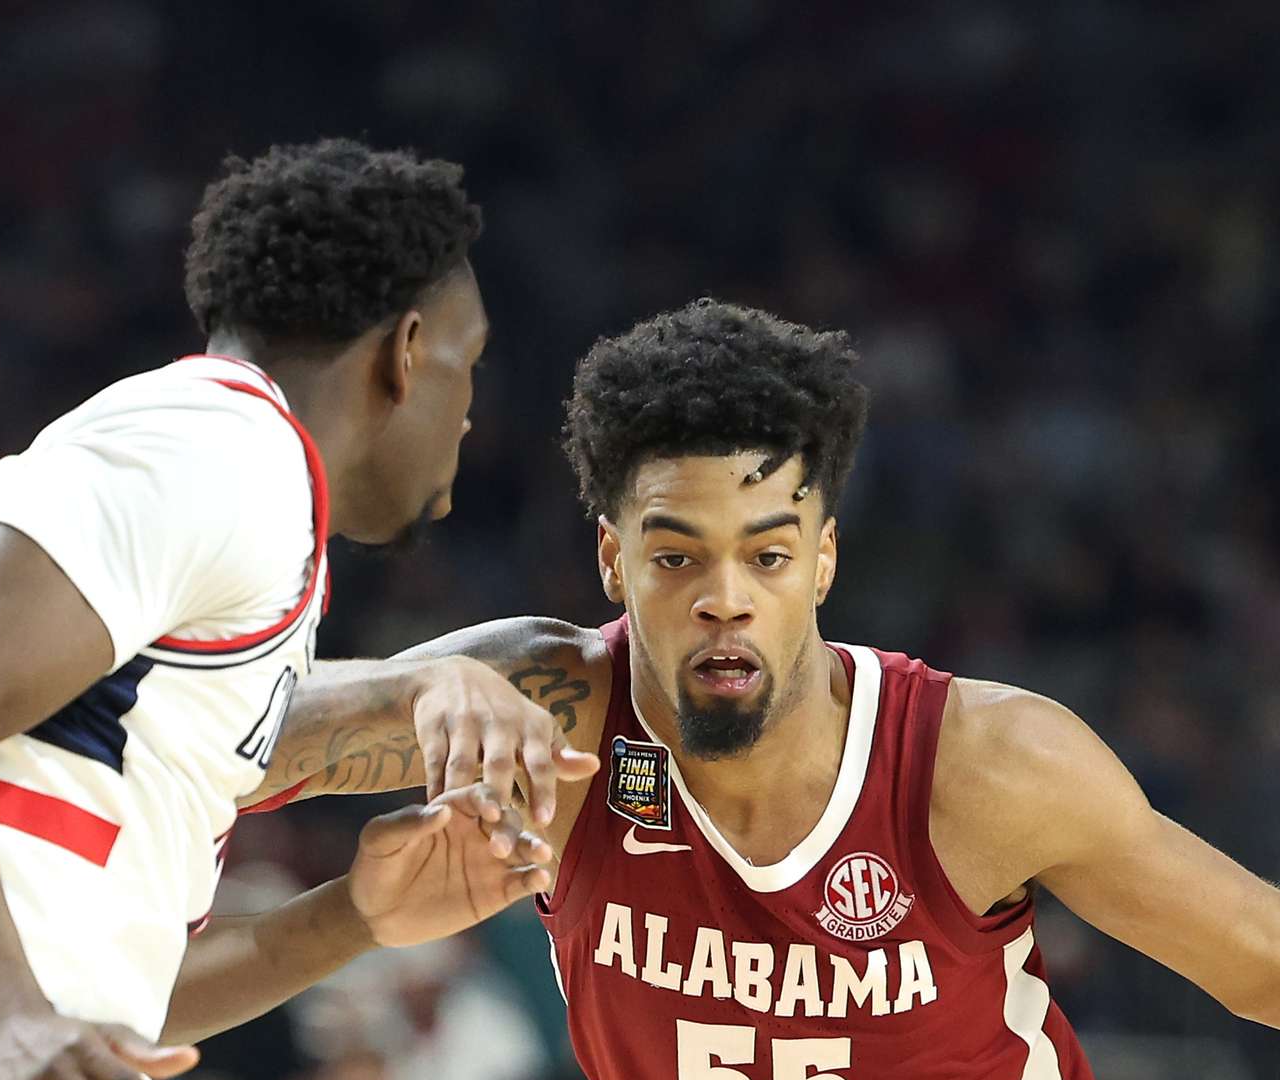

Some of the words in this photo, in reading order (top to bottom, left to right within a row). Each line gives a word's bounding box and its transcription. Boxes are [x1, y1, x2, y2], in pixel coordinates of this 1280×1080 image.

[619, 757, 656, 776] FINAL
[618, 774, 655, 793] FOUR
[623, 793, 651, 802] PHOENIX
[830, 858, 892, 919] SEC
[826, 908, 902, 940] GRADUATE
[594, 902, 937, 1018] ALABAMA
